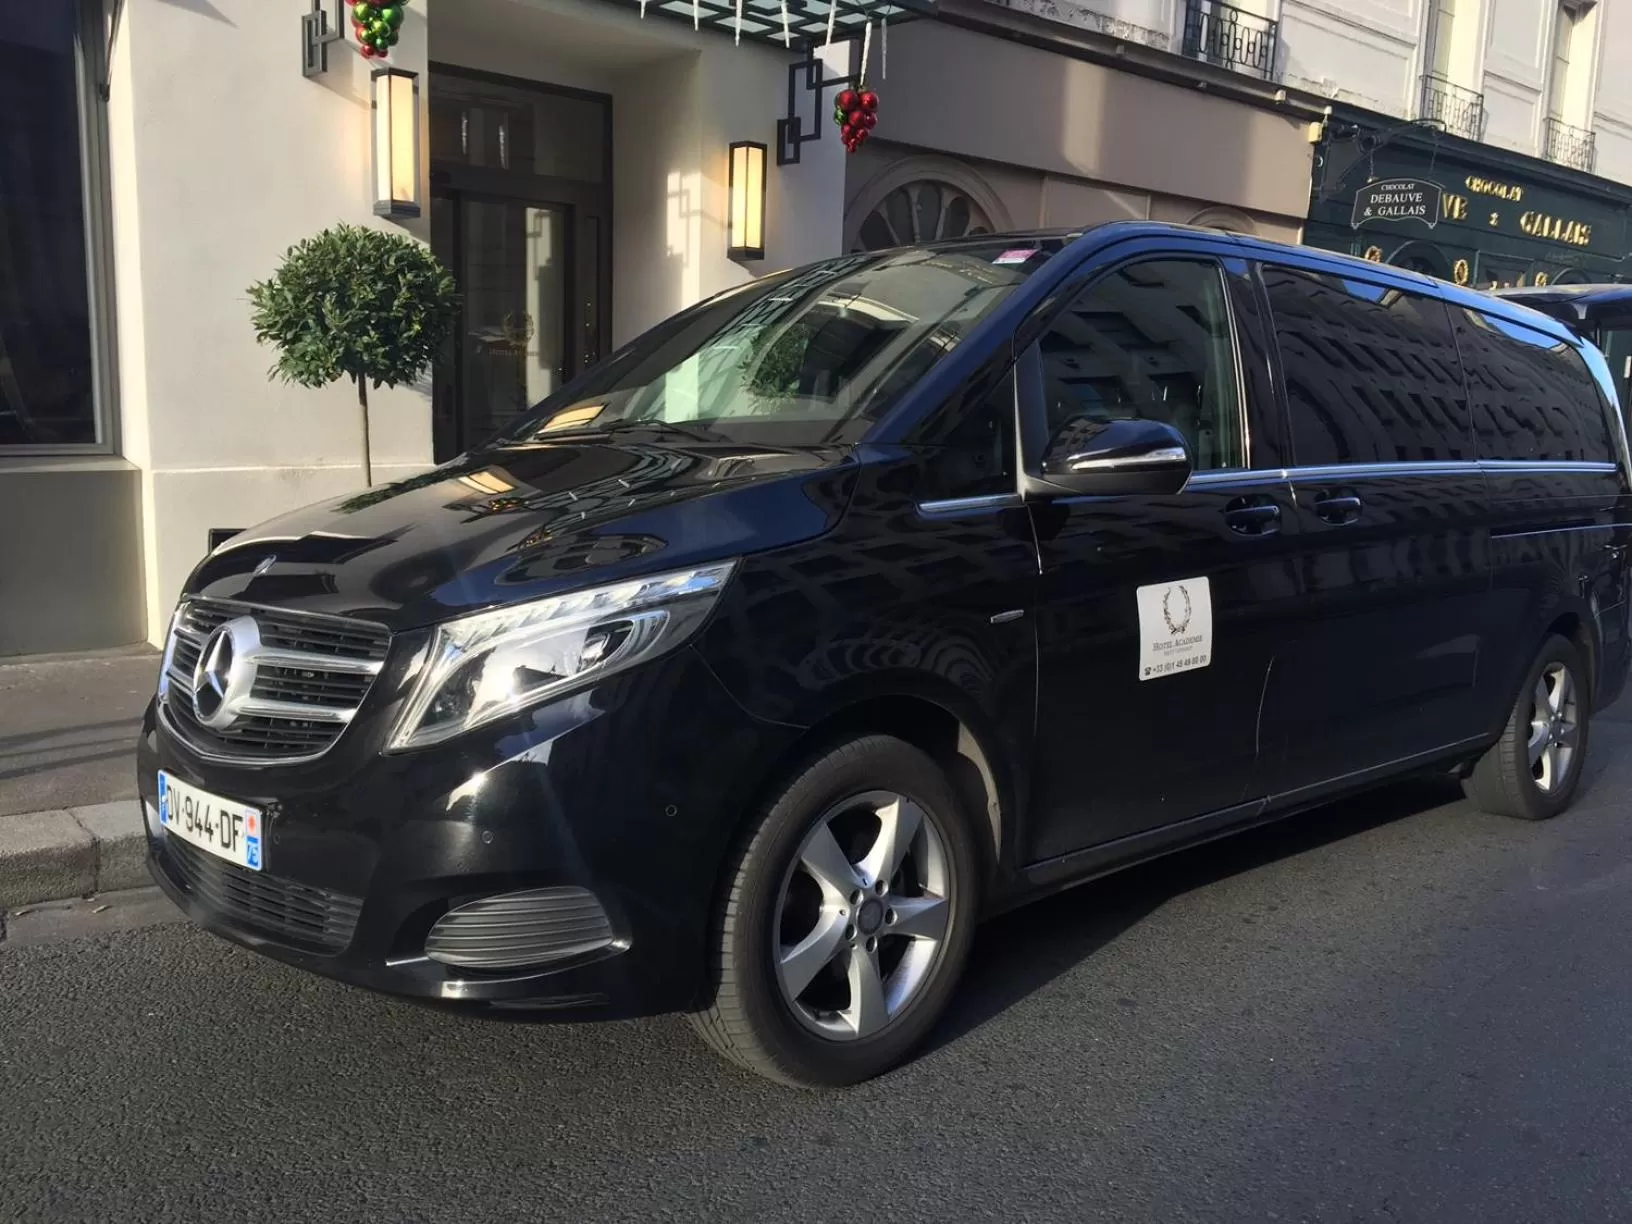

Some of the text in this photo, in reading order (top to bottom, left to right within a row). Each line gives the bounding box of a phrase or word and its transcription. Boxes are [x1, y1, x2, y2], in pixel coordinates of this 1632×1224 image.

[1380, 182, 1416, 191] CHOCOLAT
[1464, 175, 1524, 202] CHOCOLAT
[1370, 192, 1423, 204] DEBAUVE
[1363, 205, 1427, 217] & GALLAIS
[1519, 210, 1592, 246] GALLAIS
